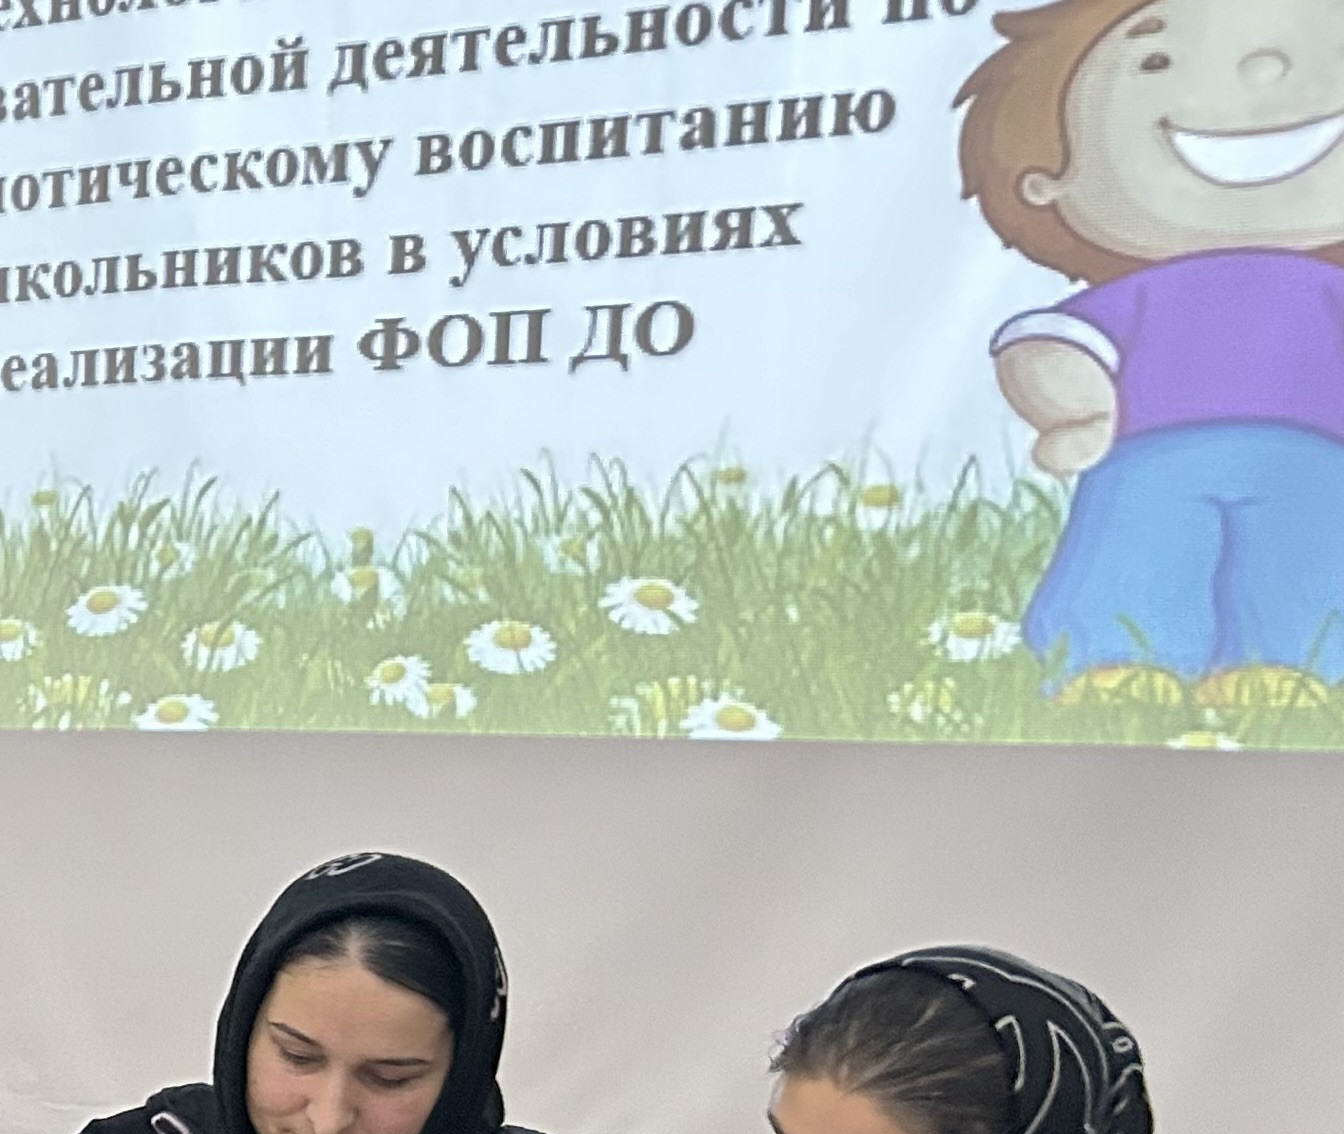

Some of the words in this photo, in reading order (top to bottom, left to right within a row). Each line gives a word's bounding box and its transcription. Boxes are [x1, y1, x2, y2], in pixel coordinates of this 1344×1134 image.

[326, 0, 850, 95] деятельности
[415, 88, 896, 177] воспитанию
[388, 233, 427, 275] в
[449, 202, 804, 288] условиях
[357, 308, 552, 371] ФОП
[568, 300, 695, 374] ДО
